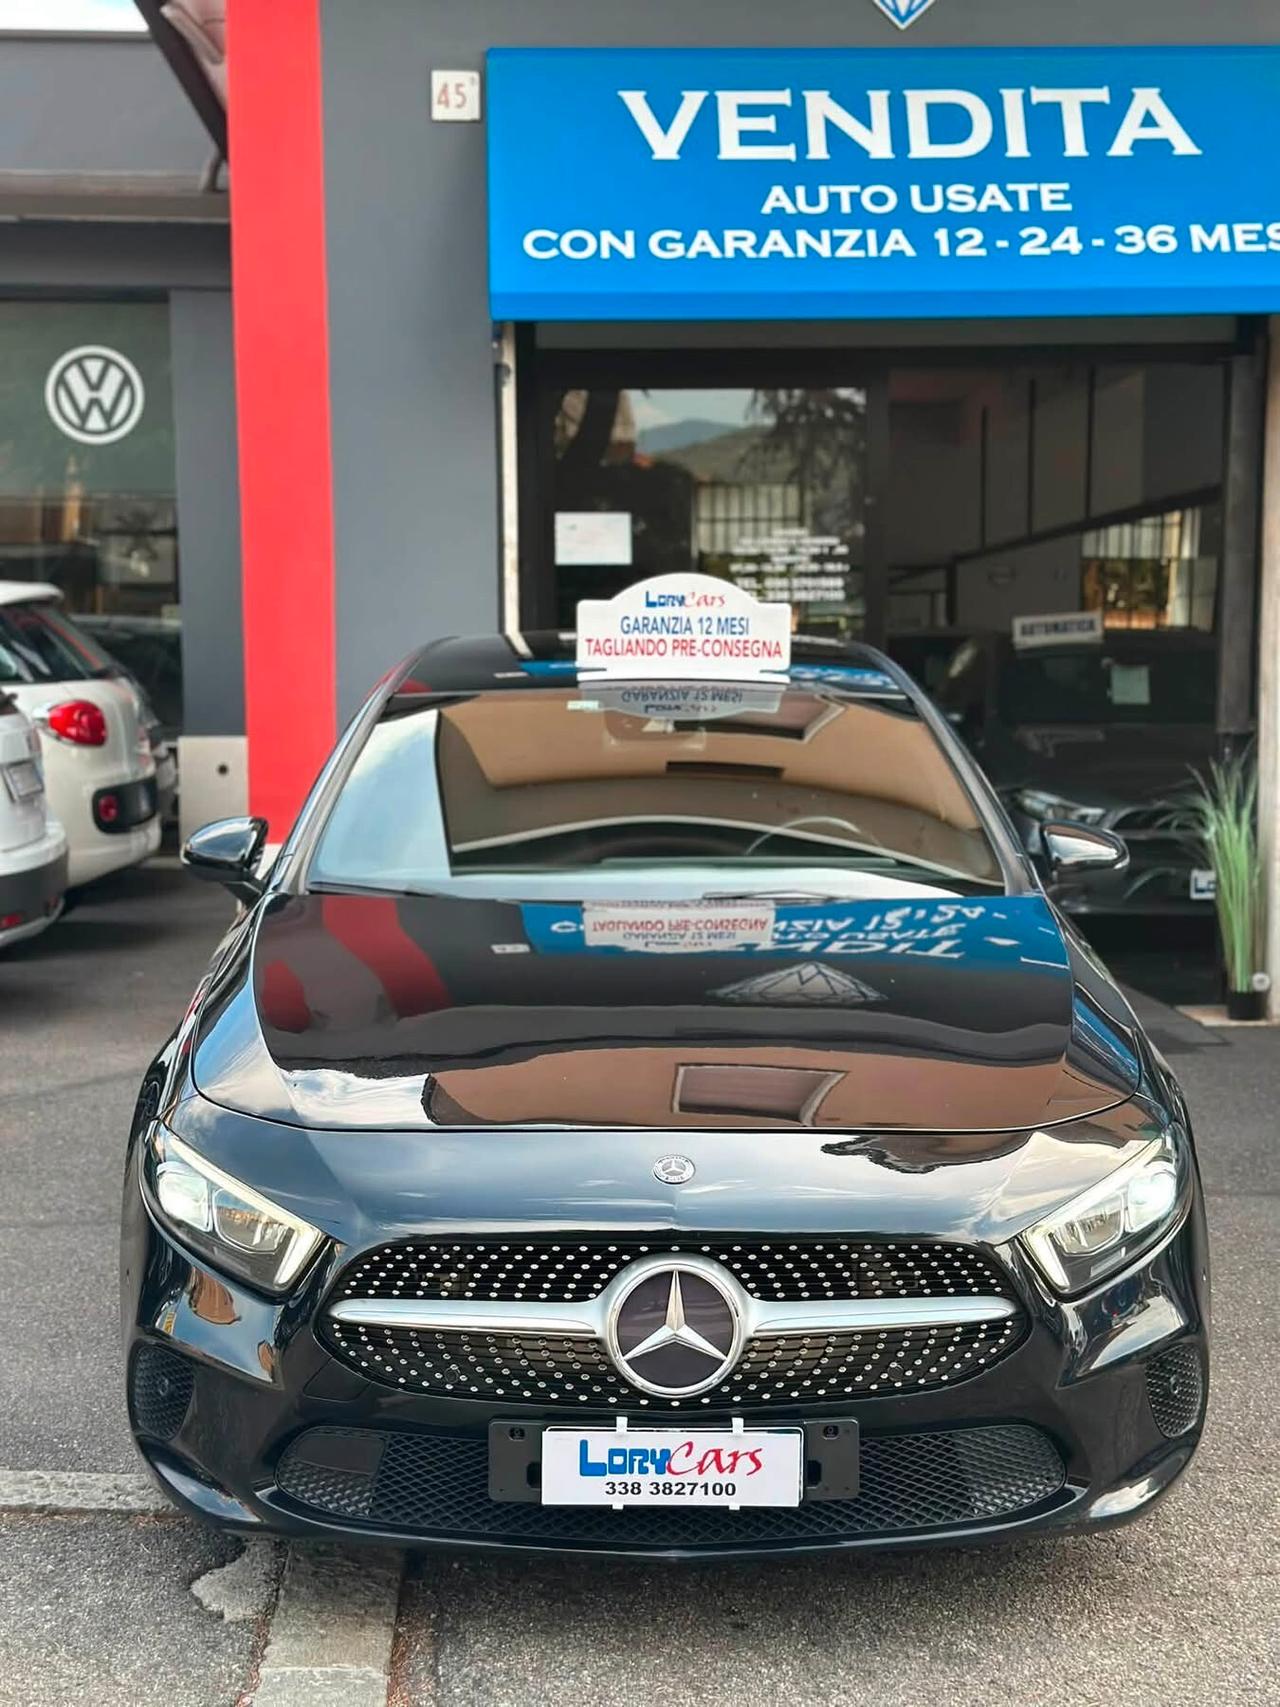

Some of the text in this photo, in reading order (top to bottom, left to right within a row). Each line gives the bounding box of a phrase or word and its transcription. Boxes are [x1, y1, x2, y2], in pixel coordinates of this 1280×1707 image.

[618, 86, 1202, 162] VENDITA
[761, 182, 1073, 215] AUTO USATE
[523, 229, 635, 259] CON
[648, 228, 916, 259] GARANZIA
[934, 228, 987, 257] 12
[1019, 226, 1083, 256] 24
[1115, 224, 1178, 254] 36
[620, 615, 749, 636] GARANZIA 12 MESI
[585, 637, 783, 659] TAGLIANDO PRE-CONSEGNA
[605, 1481, 737, 1497] 338 3827100
